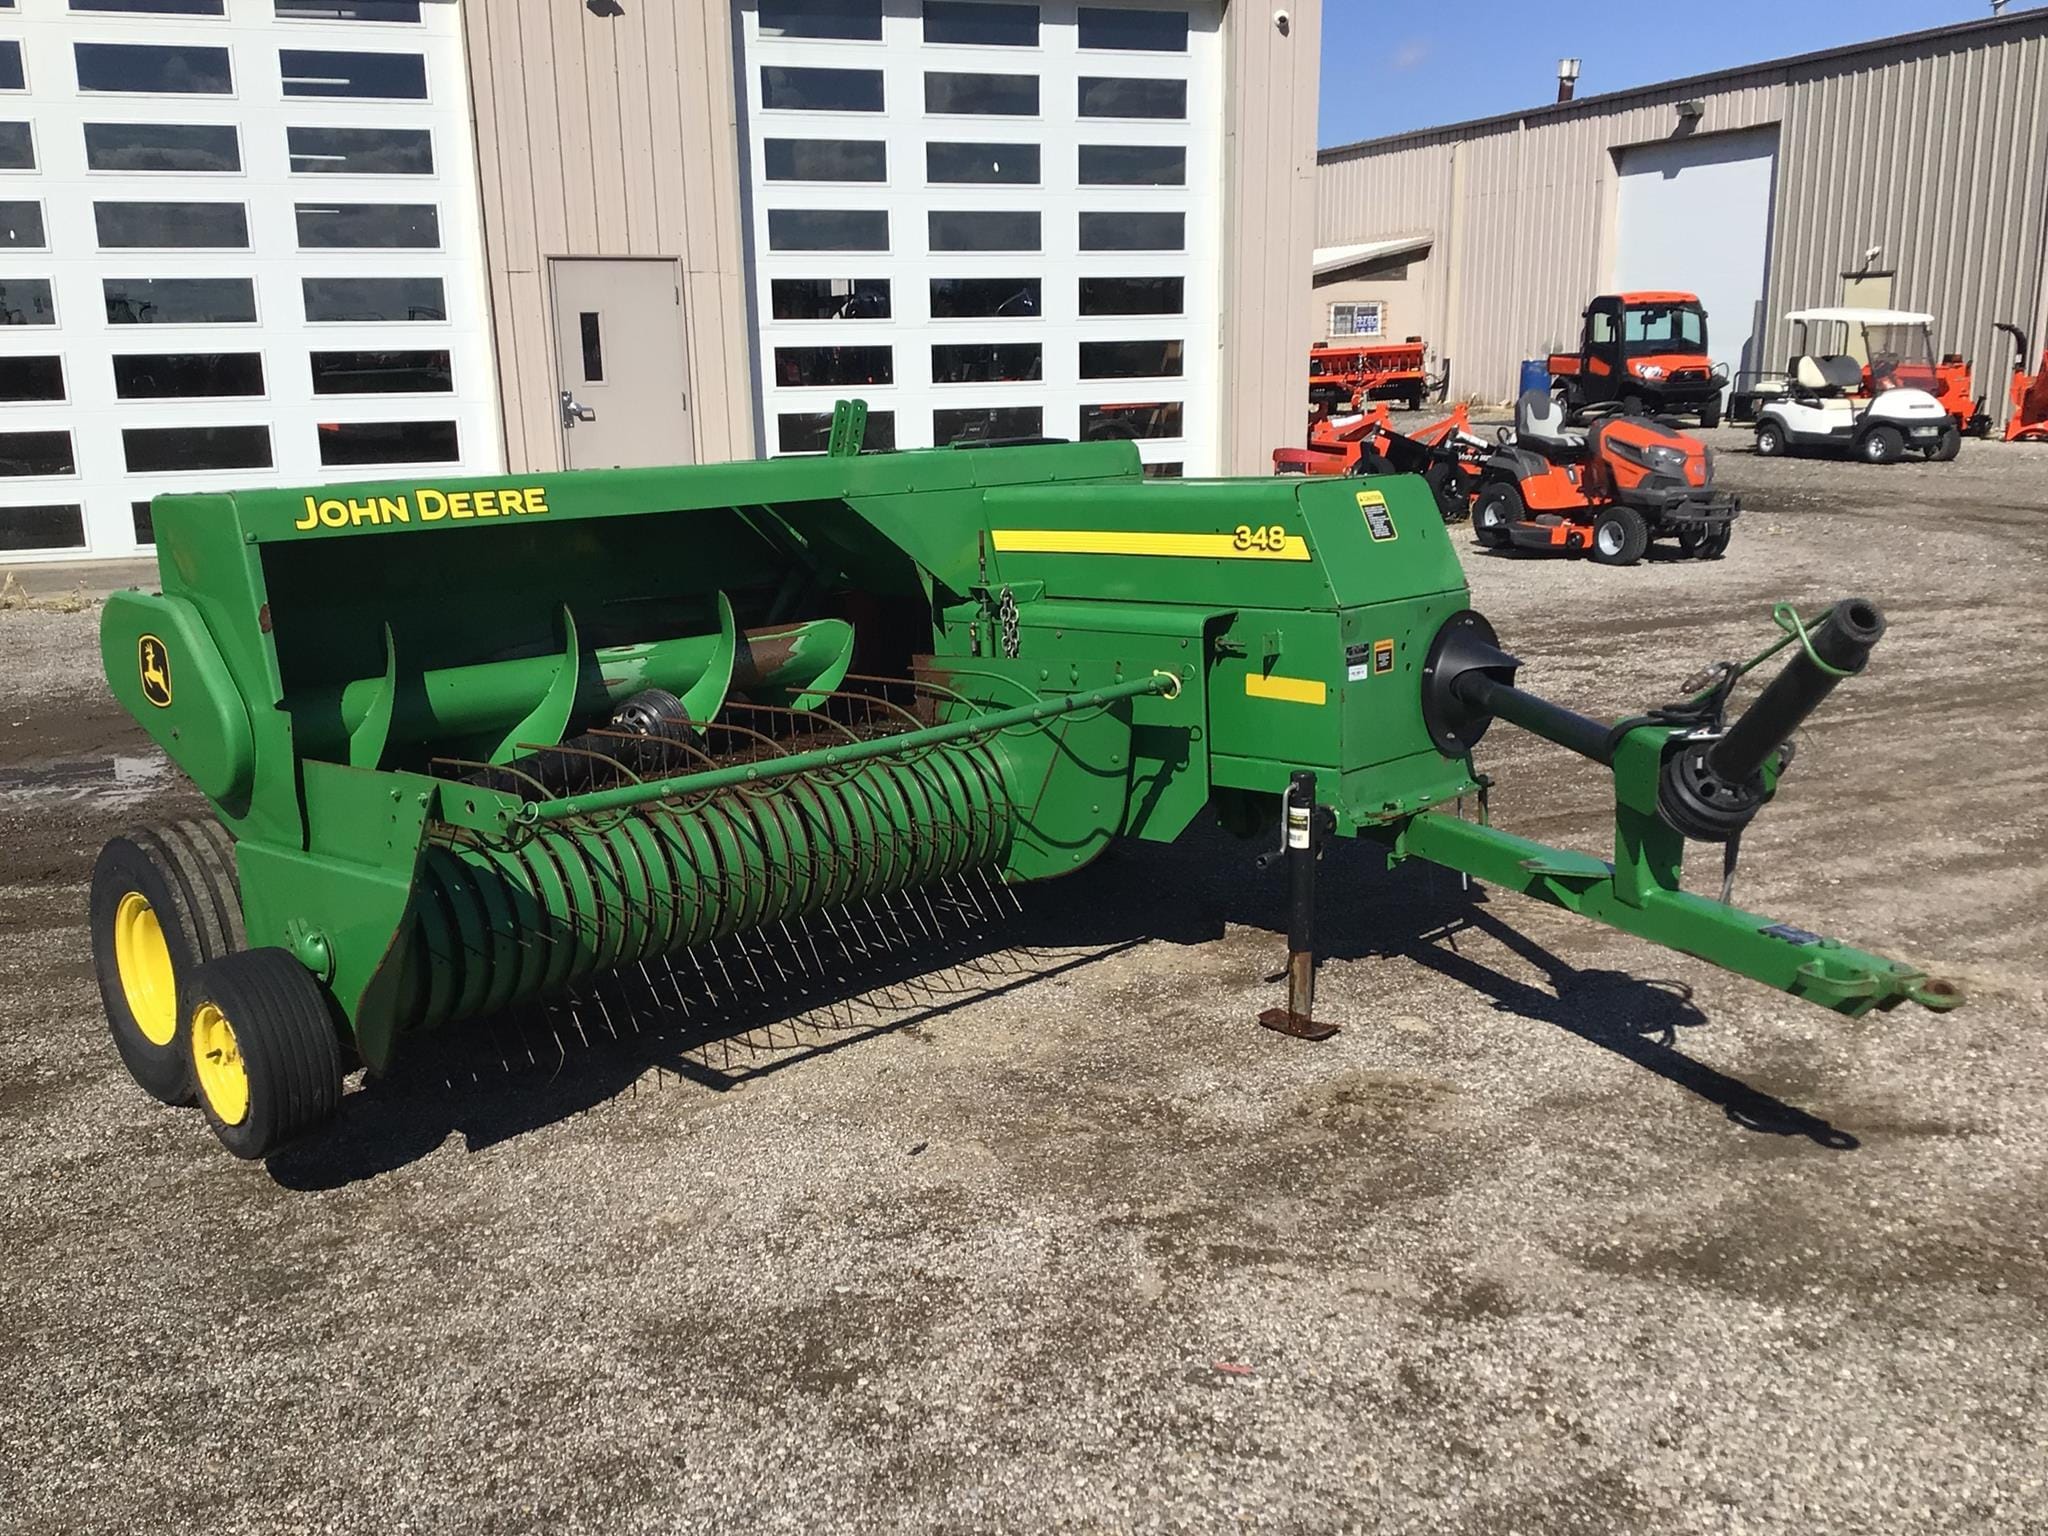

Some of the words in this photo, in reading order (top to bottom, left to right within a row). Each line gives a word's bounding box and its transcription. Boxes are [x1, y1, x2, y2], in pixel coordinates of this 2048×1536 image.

[295, 496, 411, 531] JOHN
[415, 487, 549, 521] DEERE
[1233, 524, 1286, 551] 348
